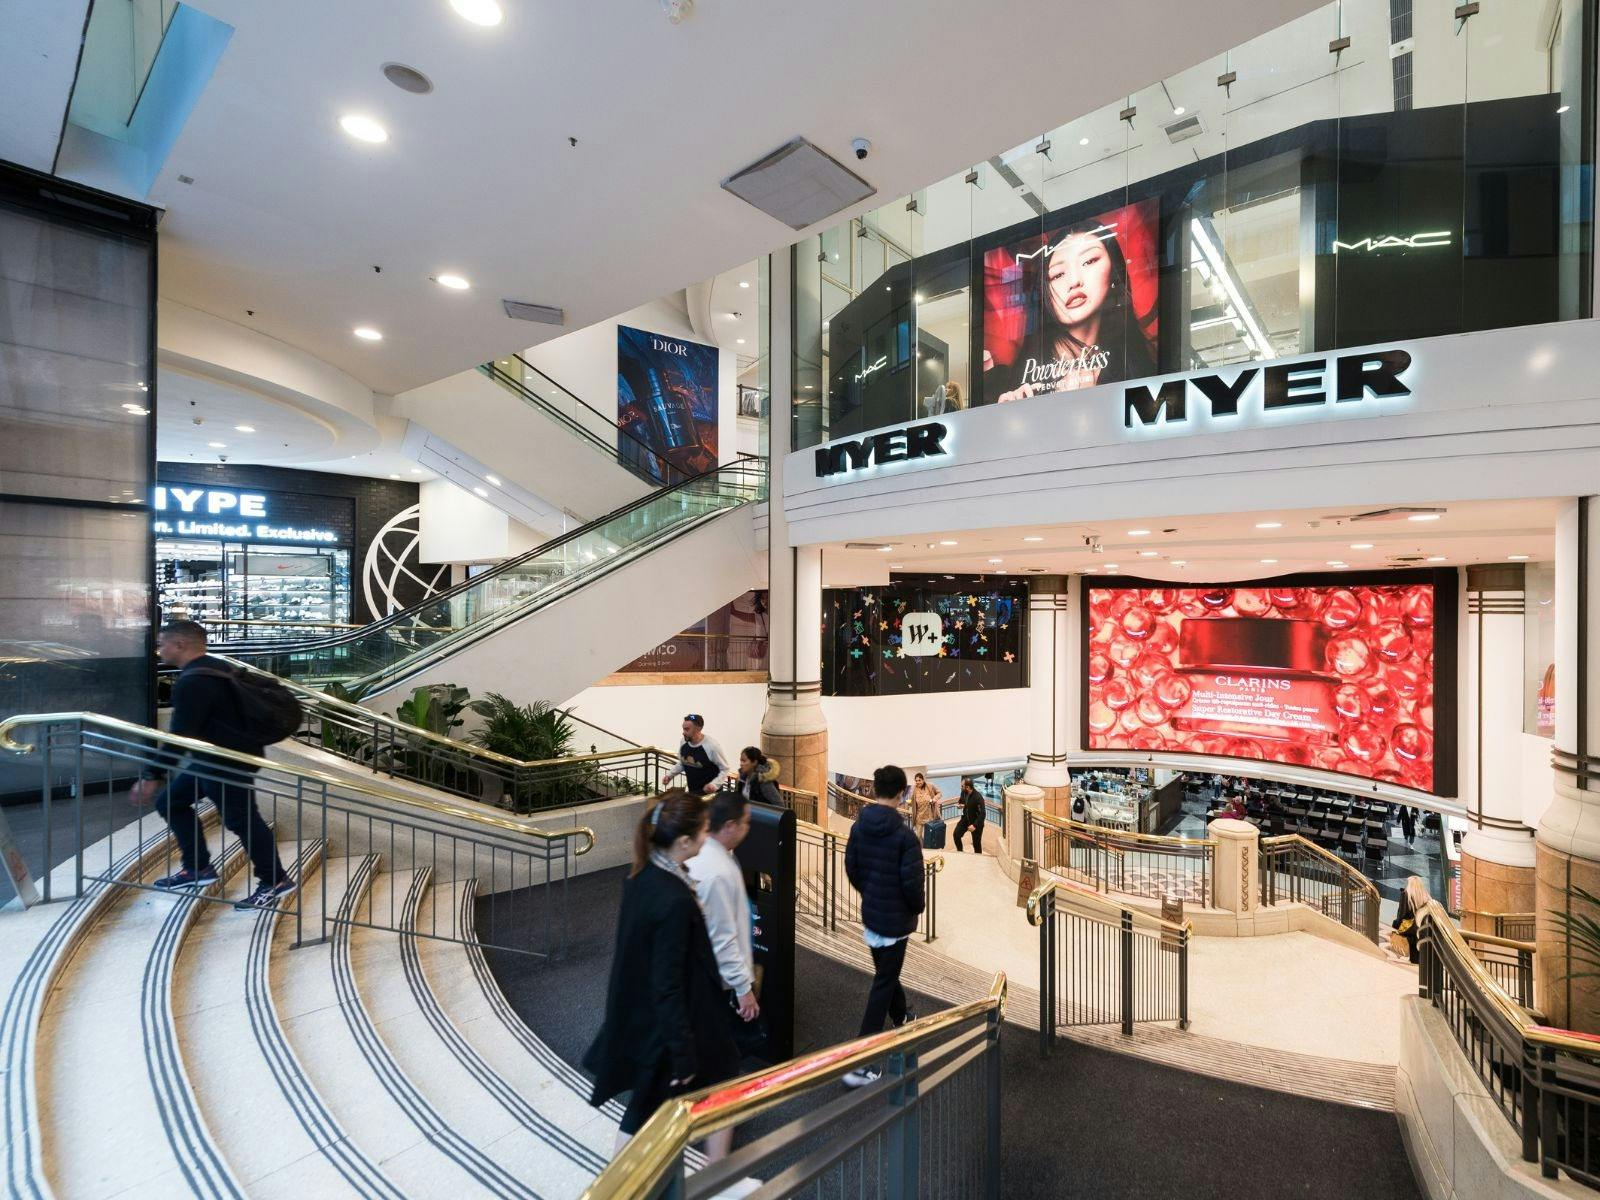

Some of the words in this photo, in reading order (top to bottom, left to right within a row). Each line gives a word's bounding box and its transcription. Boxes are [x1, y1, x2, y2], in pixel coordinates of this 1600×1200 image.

[653, 339, 688, 357] DIOR
[1124, 349, 1412, 428] MYER
[815, 422, 948, 478] MYER
[178, 521, 252, 537] Limited.
[256, 525, 339, 542] Exclusive.
[1215, 676, 1292, 691] CLARINS
[1192, 690, 1254, 702] Multi-Intensive
[1254, 694, 1276, 704] Jour
[1192, 704, 1216, 715] Super
[1216, 706, 1264, 718] Restorative
[1264, 711, 1281, 720] Day
[1283, 711, 1313, 721] Cream
